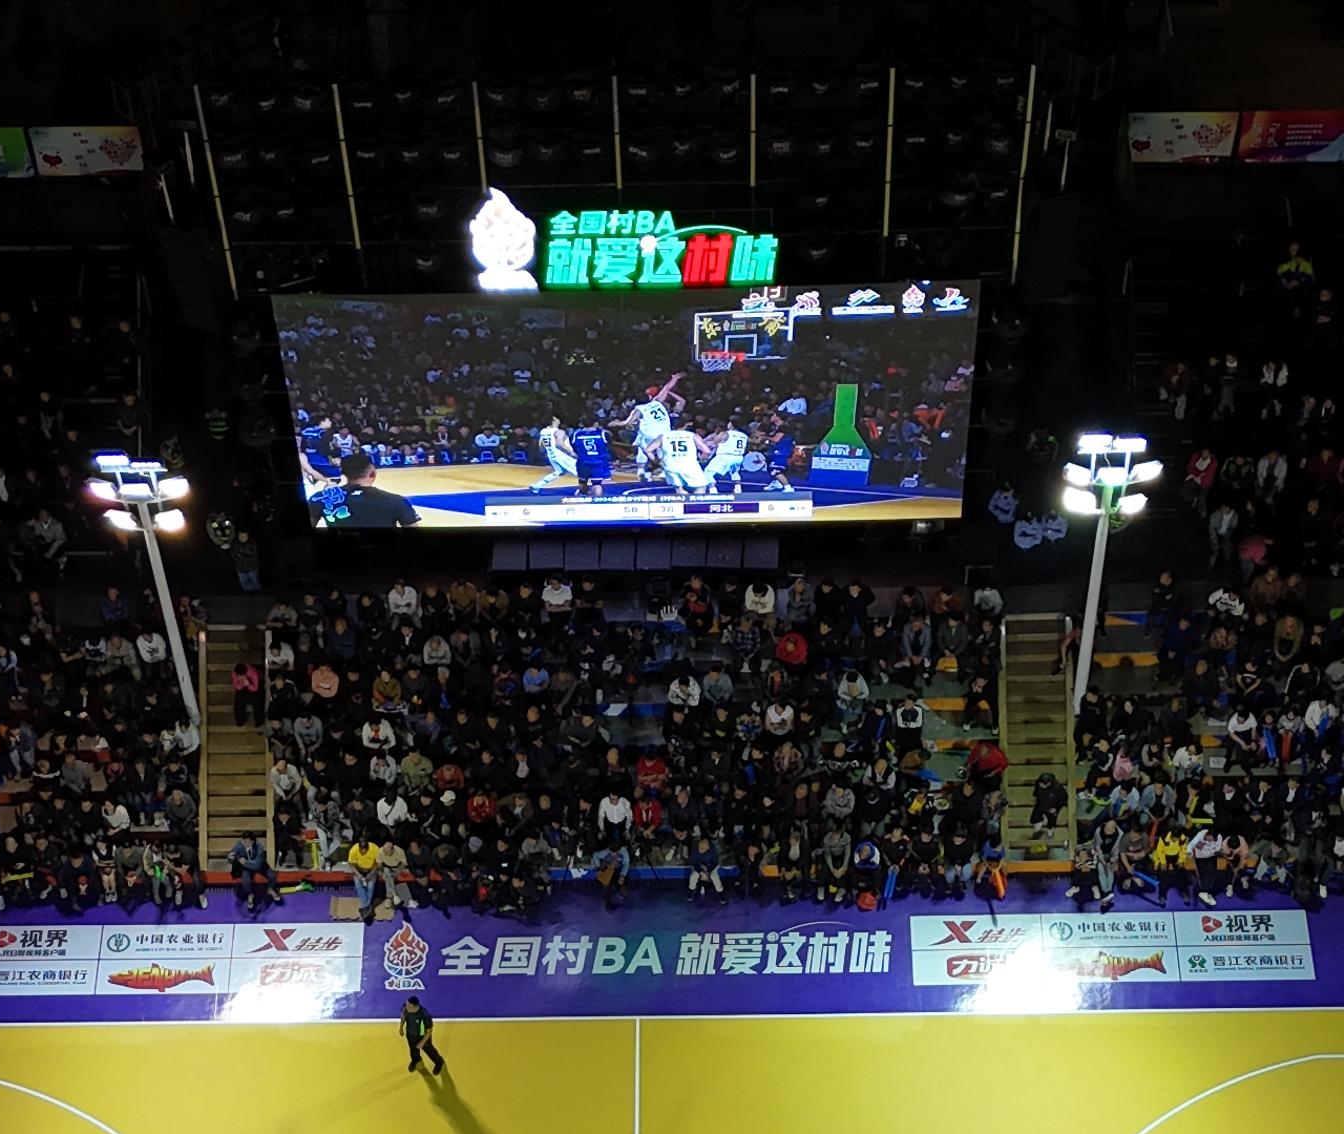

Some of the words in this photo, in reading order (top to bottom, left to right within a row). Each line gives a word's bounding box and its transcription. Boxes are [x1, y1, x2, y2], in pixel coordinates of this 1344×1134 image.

[550, 210, 676, 234] 全国村BA
[546, 232, 779, 284] 就爱这村味
[1077, 921, 1167, 933] 中国农业银行
[1225, 914, 1275, 933] 视界
[20, 929, 68, 948] 视界
[136, 933, 225, 944] 中国农业银行
[438, 935, 664, 977] 全国村BA
[675, 930, 892, 975] 就爱这村味
[1212, 954, 1304, 967] 晋江农商银行
